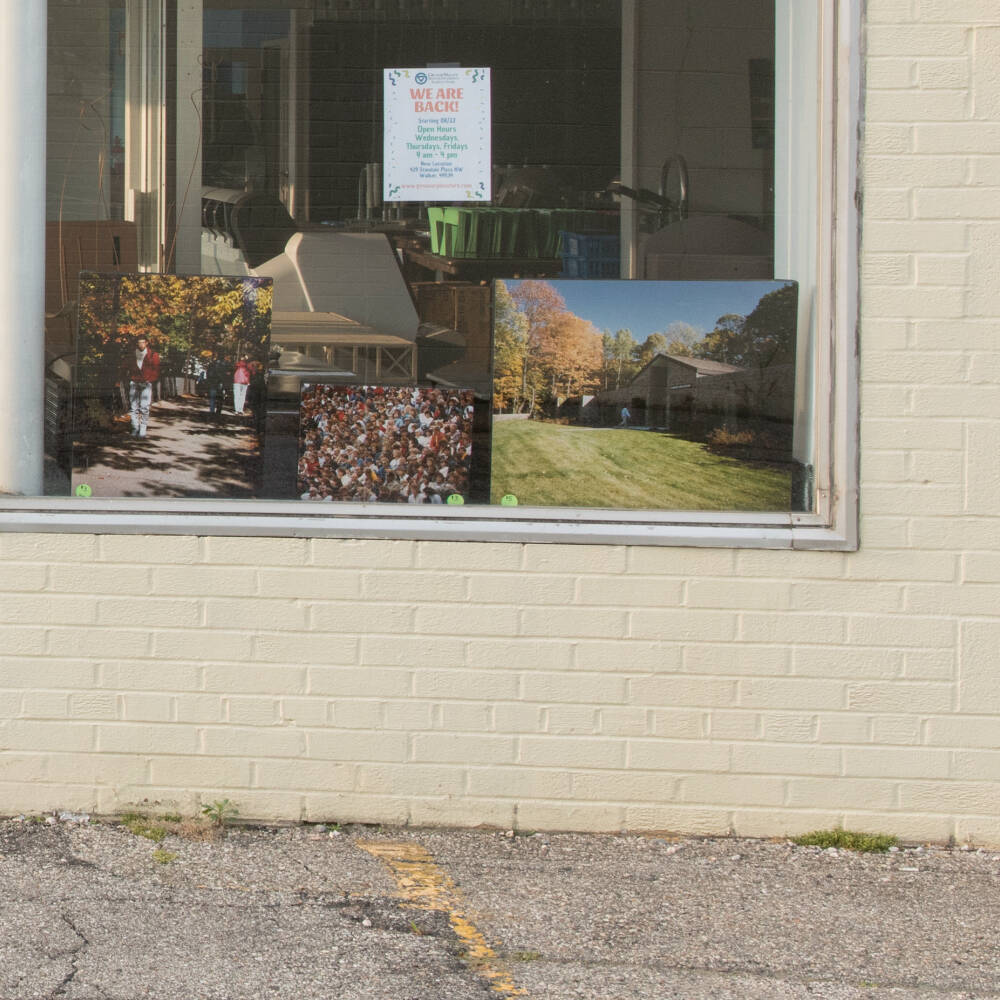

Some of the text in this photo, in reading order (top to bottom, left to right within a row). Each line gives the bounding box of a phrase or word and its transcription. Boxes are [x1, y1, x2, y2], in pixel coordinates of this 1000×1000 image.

[409, 87, 465, 100] WE ARE
[414, 100, 460, 113] BACK!
[417, 117, 439, 125] Starting
[417, 125, 457, 134] Open Hours
[443, 142, 469, 151] Fridays
